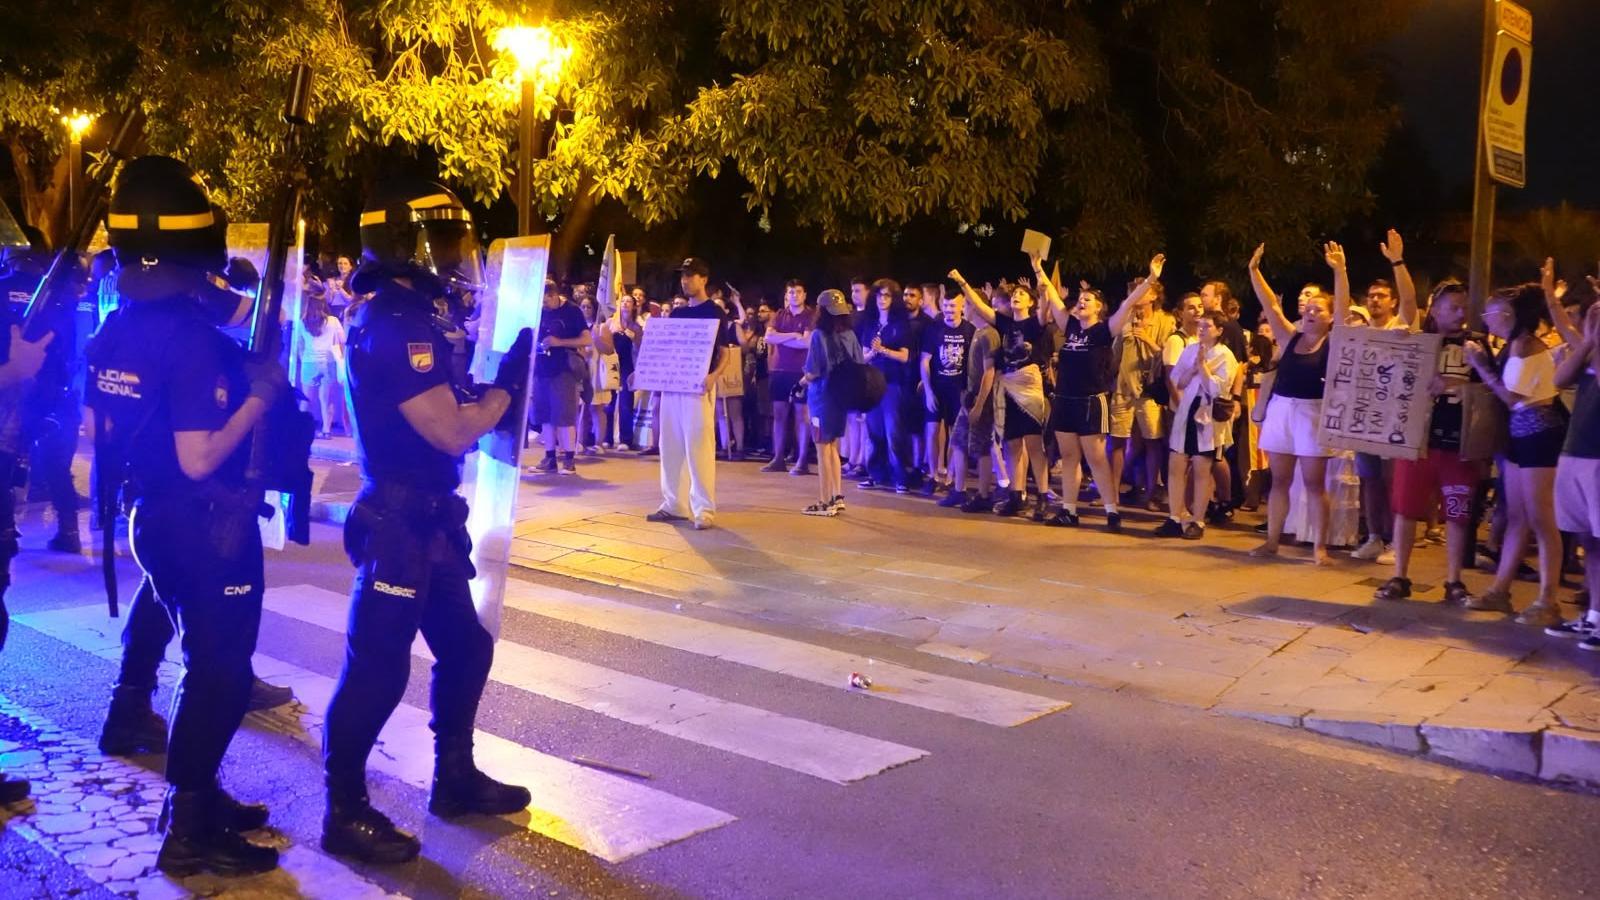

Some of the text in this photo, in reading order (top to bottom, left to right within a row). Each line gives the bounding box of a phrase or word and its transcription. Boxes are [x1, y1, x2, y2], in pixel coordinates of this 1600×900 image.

[1326, 346, 1355, 430] ELS TEUS
[1376, 363, 1395, 401] OLOR
[224, 584, 251, 595] CNP
